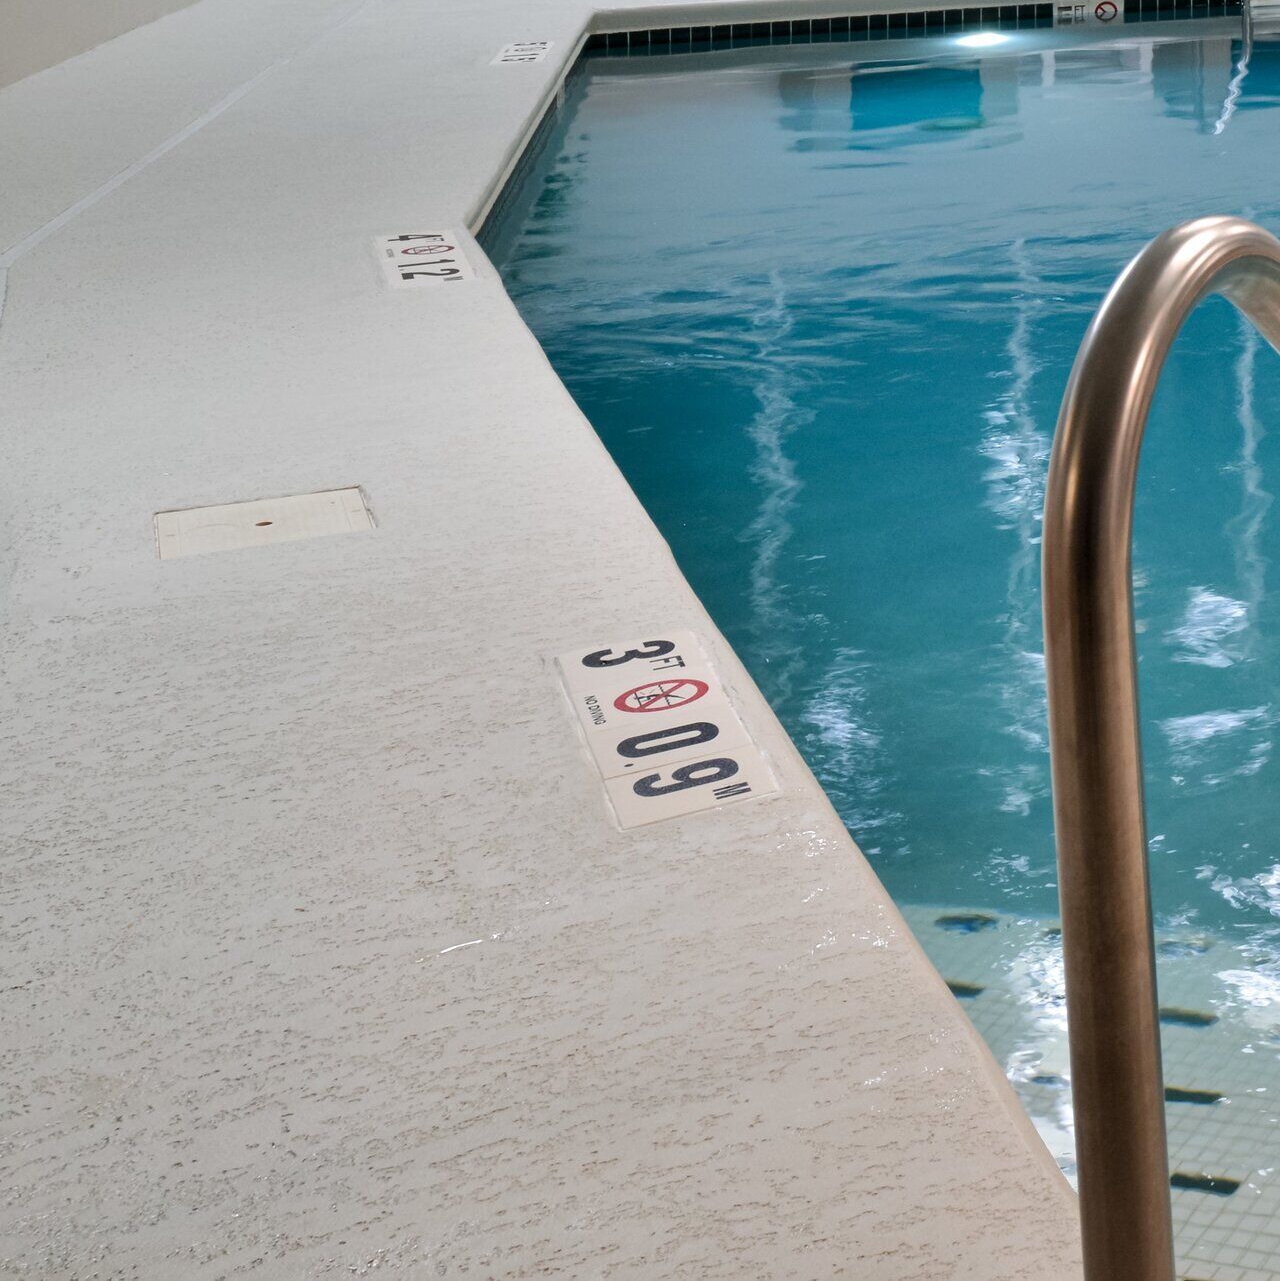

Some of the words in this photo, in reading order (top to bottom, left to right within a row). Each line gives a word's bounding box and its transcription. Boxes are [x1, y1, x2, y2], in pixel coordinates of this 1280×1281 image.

[581, 640, 675, 668] 3
[649, 655, 686, 671] FT
[584, 695, 595, 706] NO
[588, 705, 607, 726] DIVING
[712, 782, 752, 800] M
